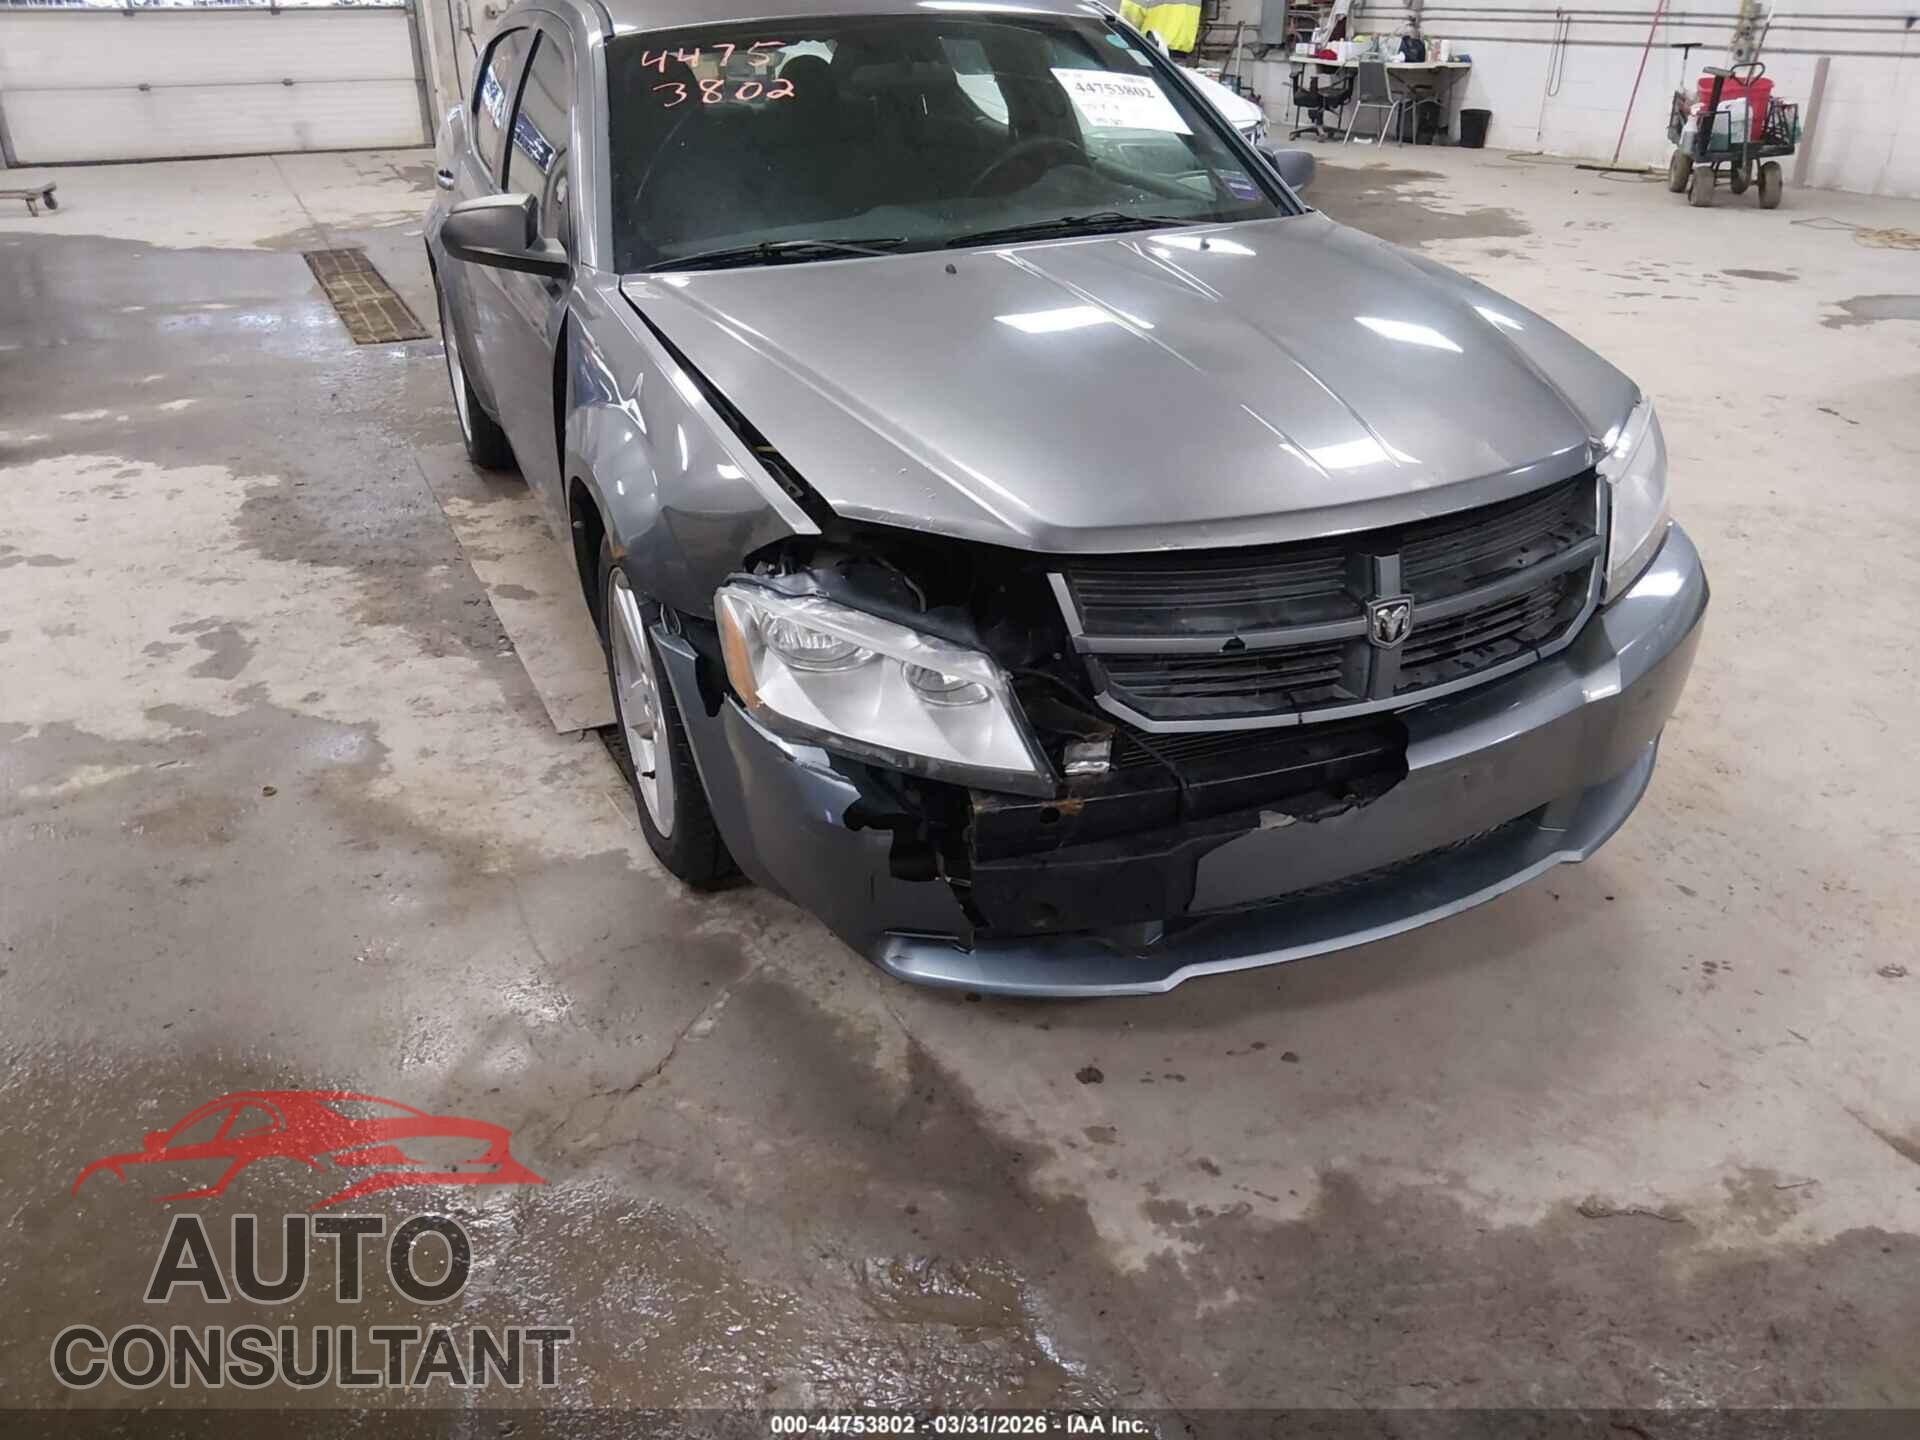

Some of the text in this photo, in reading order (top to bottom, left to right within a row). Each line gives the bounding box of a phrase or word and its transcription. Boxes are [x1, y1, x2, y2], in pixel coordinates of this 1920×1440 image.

[641, 41, 786, 73] 4475
[652, 78, 795, 107] 3802
[1074, 81, 1155, 98] 44753802
